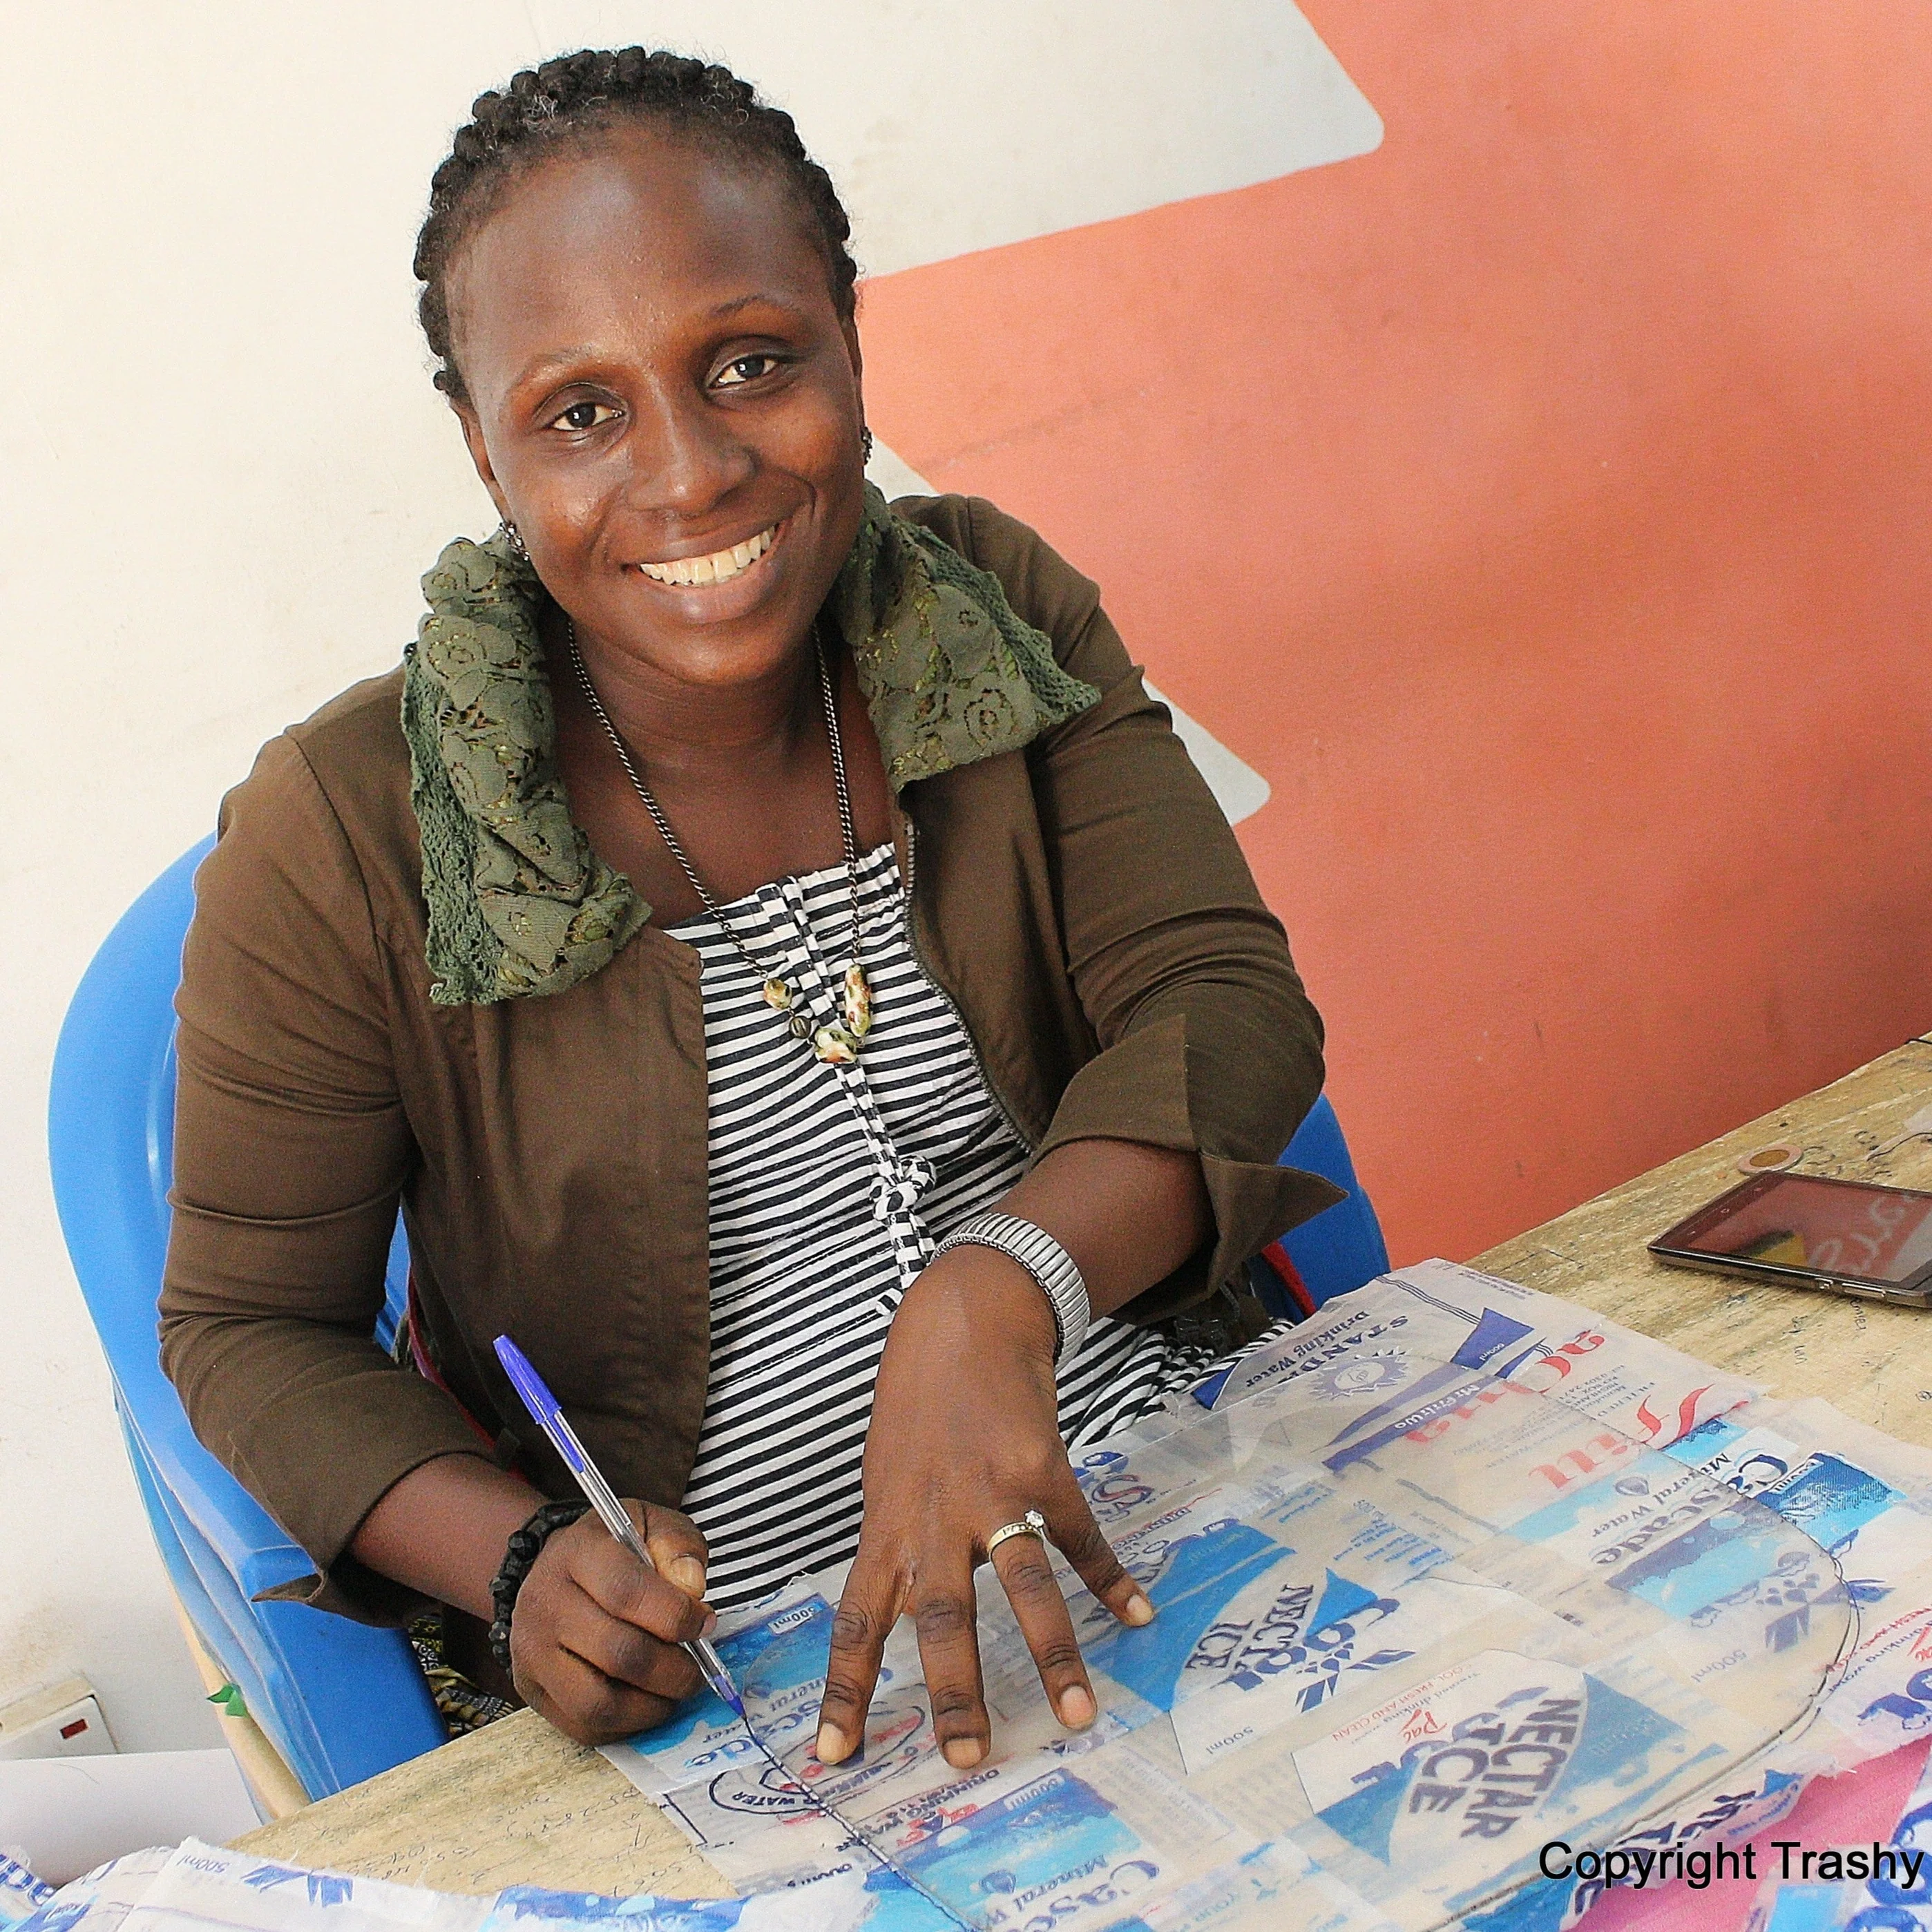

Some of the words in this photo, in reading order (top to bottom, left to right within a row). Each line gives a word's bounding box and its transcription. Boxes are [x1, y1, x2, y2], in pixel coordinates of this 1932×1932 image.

[1293, 1311, 1370, 1358] Drinking
[1246, 1356, 1297, 1387] Water
[1591, 1454, 1788, 1565] Cascade
[1591, 1504, 1654, 1538] Water
[1205, 1727, 1254, 1754] 500ml
[1402, 1710, 1448, 1745] Pac
[1460, 1698, 1582, 1839] NECTAR
[732, 1791, 796, 1806] WATER
[176, 1854, 230, 1874] 500ml
[1012, 1854, 1109, 1912] Mineral
